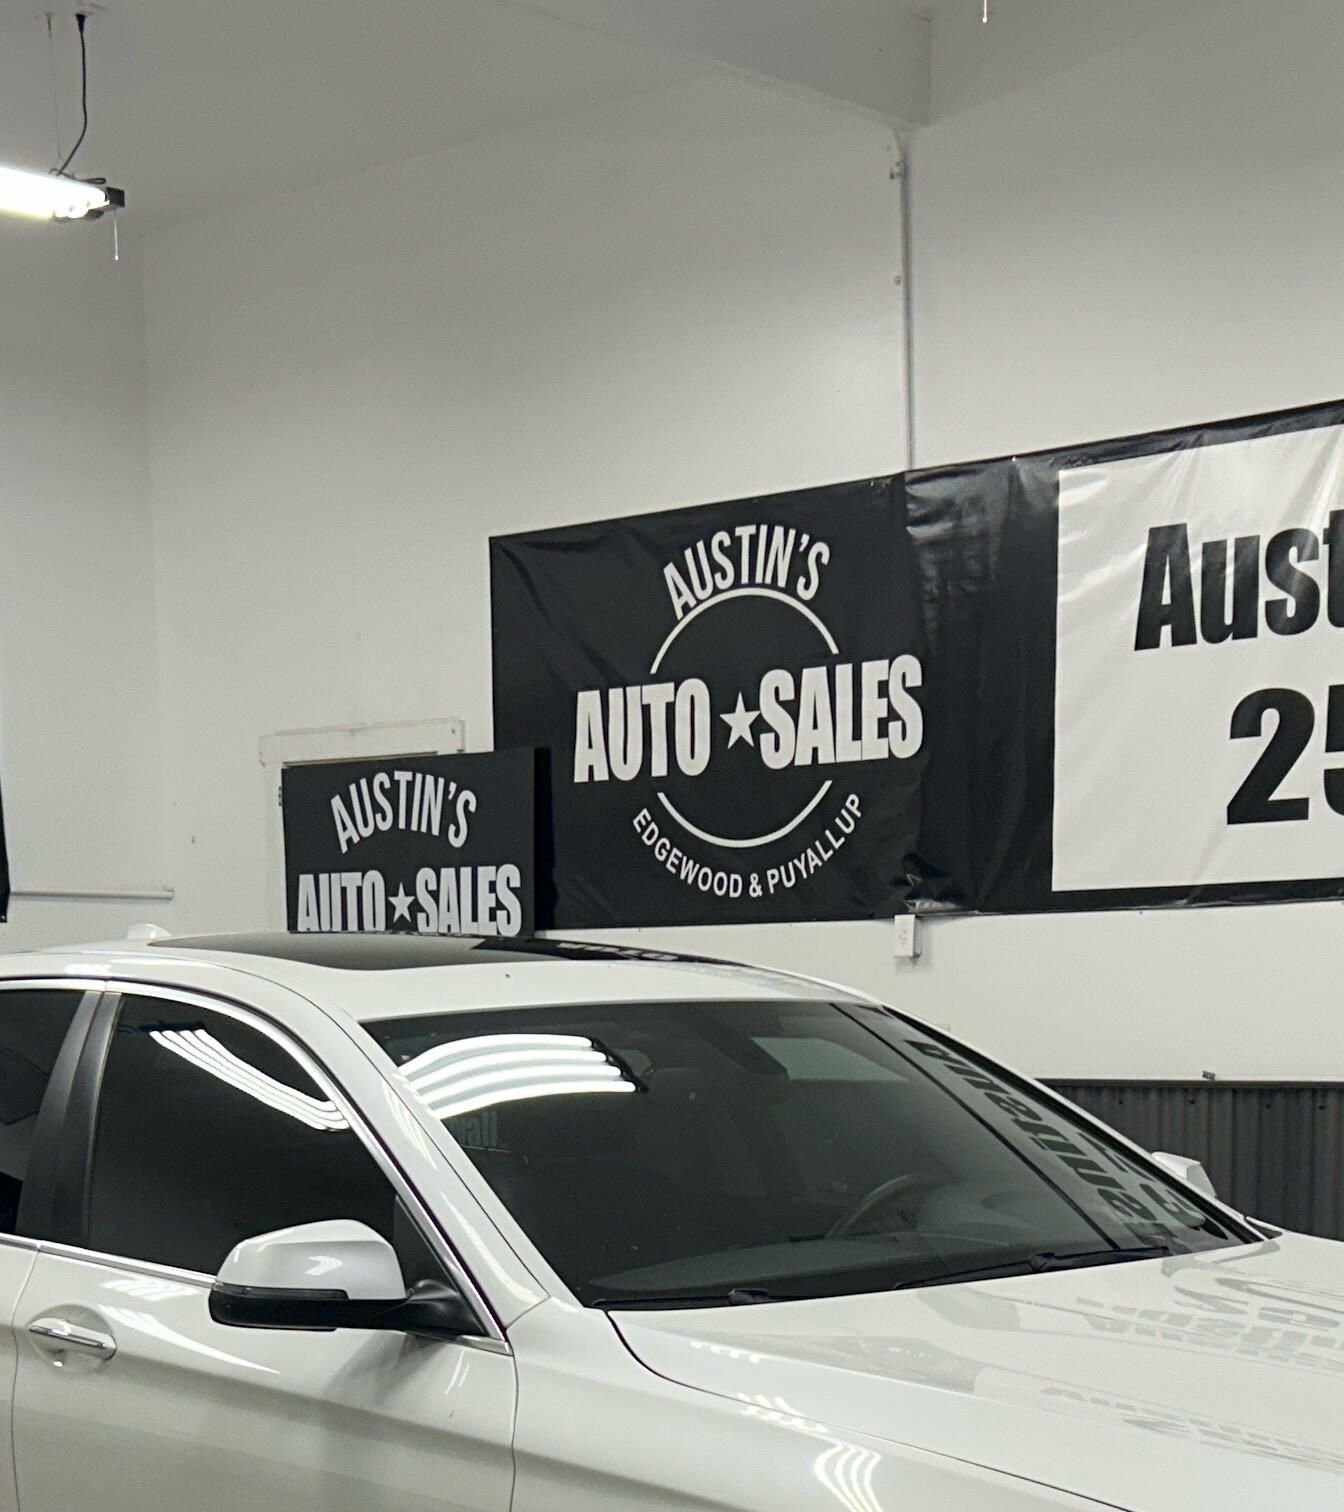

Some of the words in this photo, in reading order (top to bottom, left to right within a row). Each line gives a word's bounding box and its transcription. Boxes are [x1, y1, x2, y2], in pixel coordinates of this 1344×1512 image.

[662, 524, 831, 621] AUSTIN'S
[573, 677, 711, 784] AUTO
[759, 653, 924, 771] SALES
[330, 770, 477, 854] AUSTIN'S
[632, 807, 743, 898] EDGEWOOD
[748, 872, 763, 897] &
[766, 793, 862, 894] PUYALLUP
[297, 869, 387, 934] AUTO
[415, 863, 523, 937] SALES
